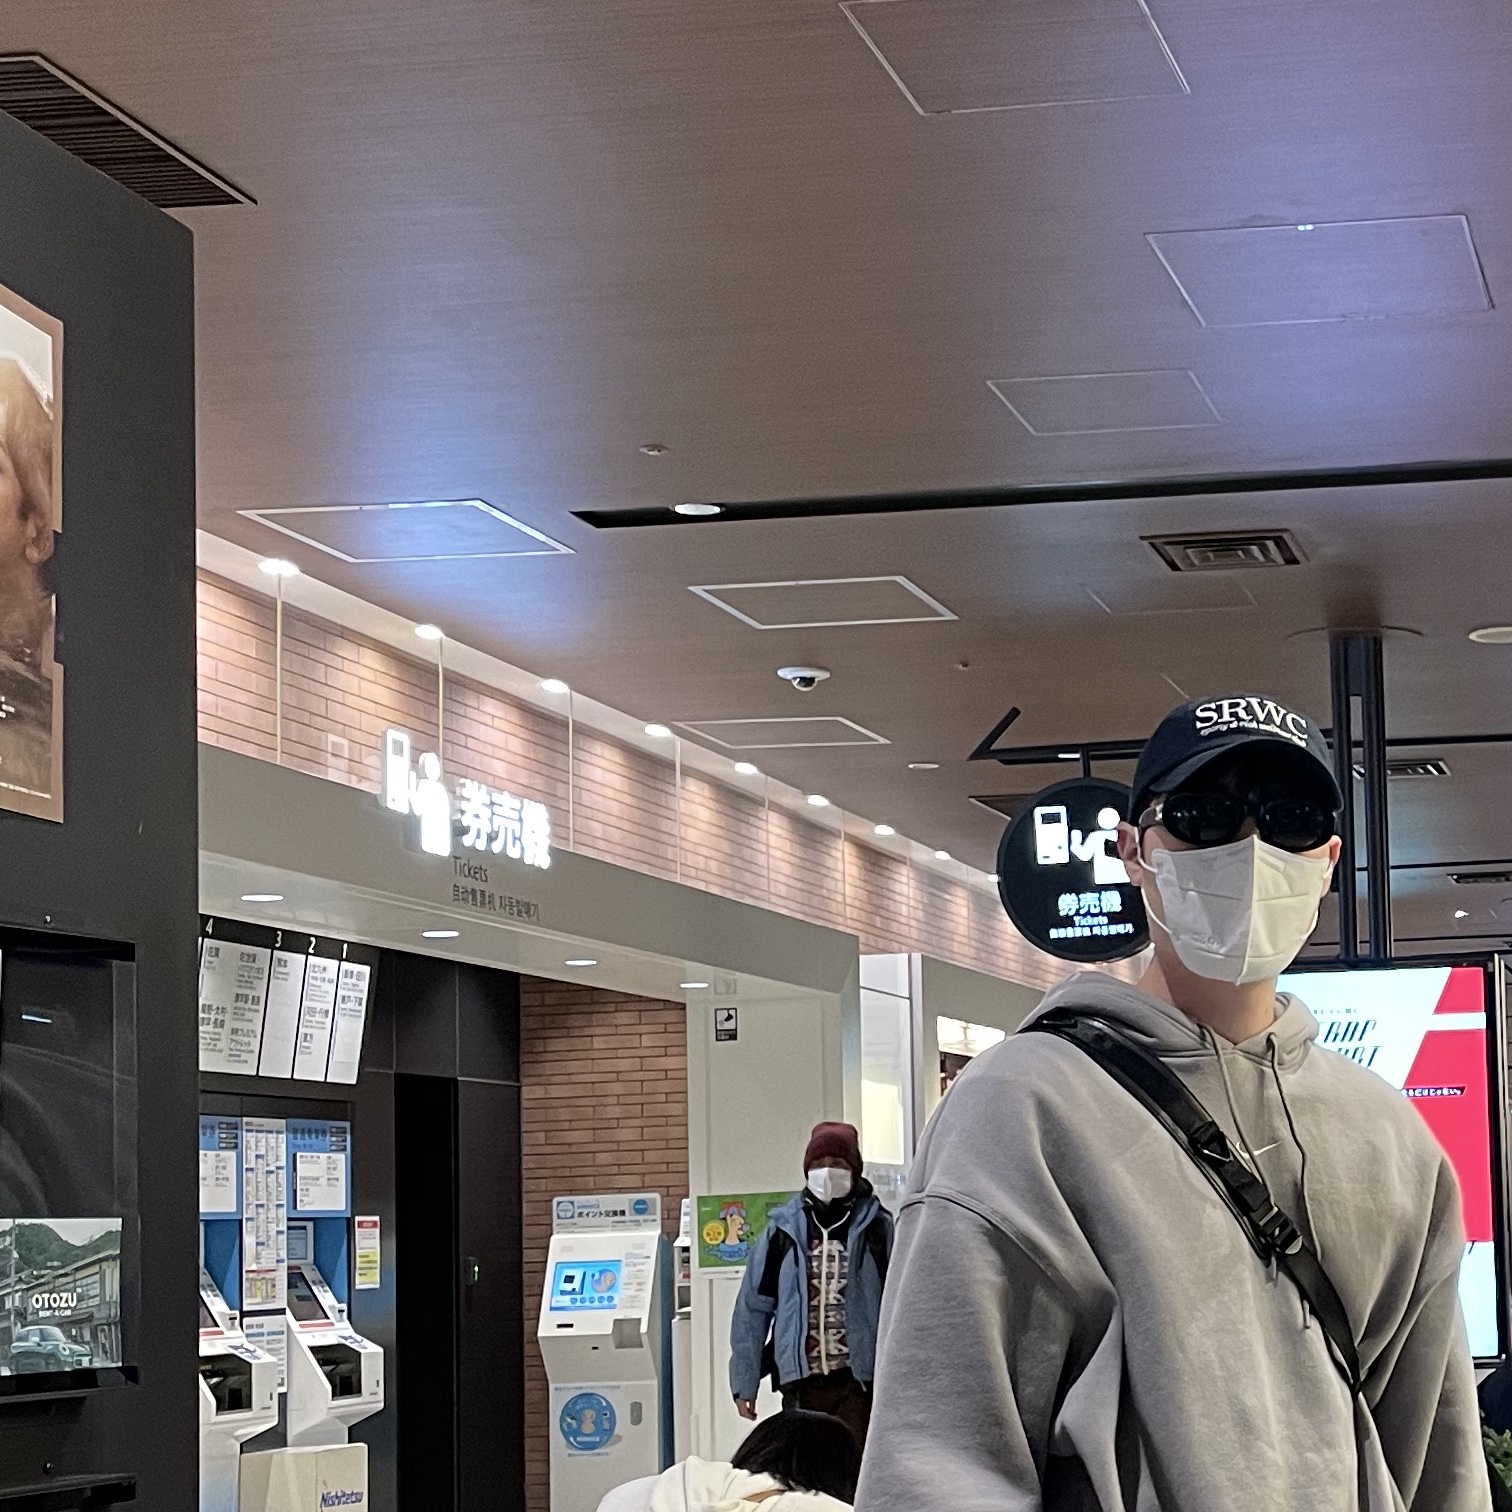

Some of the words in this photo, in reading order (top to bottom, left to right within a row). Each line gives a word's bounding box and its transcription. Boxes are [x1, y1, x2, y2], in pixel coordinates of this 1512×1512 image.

[1195, 697, 1308, 739] SRWC
[453, 855, 489, 883] Tickets
[275, 931, 283, 948] 3
[308, 937, 316, 954] 2
[342, 943, 348, 960] 1
[31, 1292, 77, 1309] OTOZU
